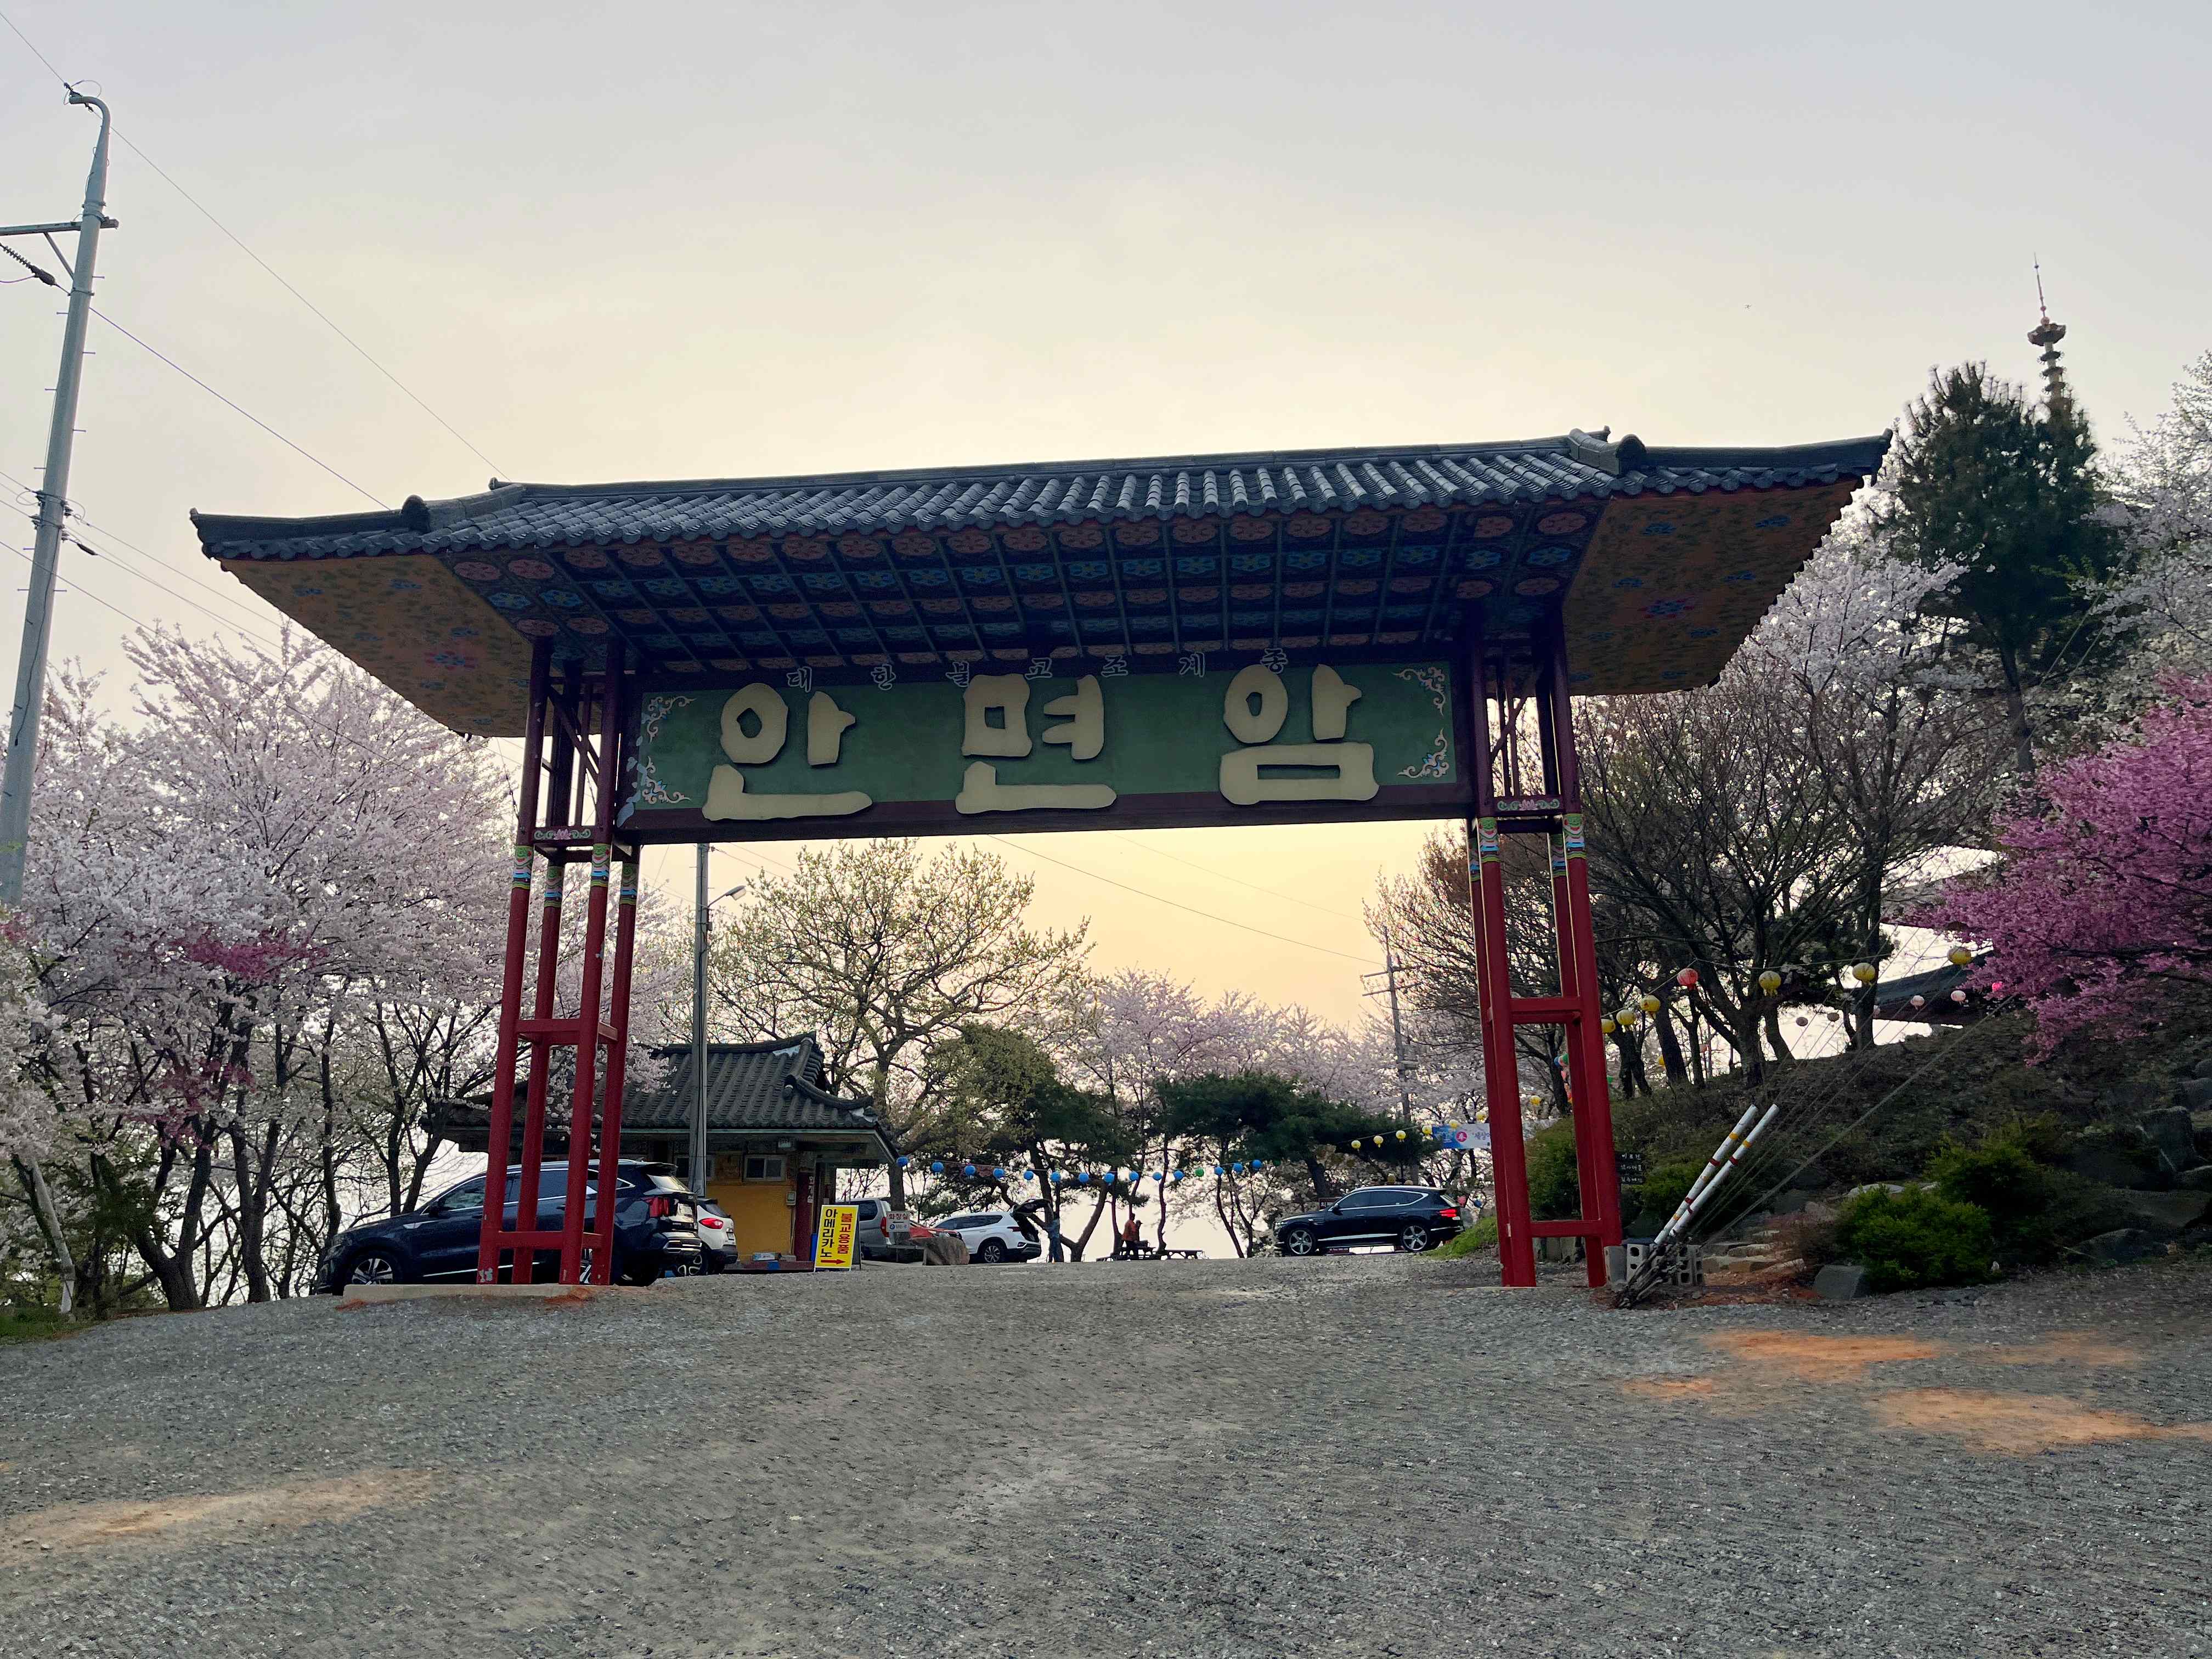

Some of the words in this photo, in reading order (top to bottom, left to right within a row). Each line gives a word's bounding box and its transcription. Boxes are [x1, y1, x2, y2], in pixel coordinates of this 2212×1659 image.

[787, 647, 1288, 693] 대한불교조계종
[702, 664, 1380, 821] 안면암
[820, 1209, 838, 1257] 아메리카노
[837, 1213, 853, 1254] 불교용품
